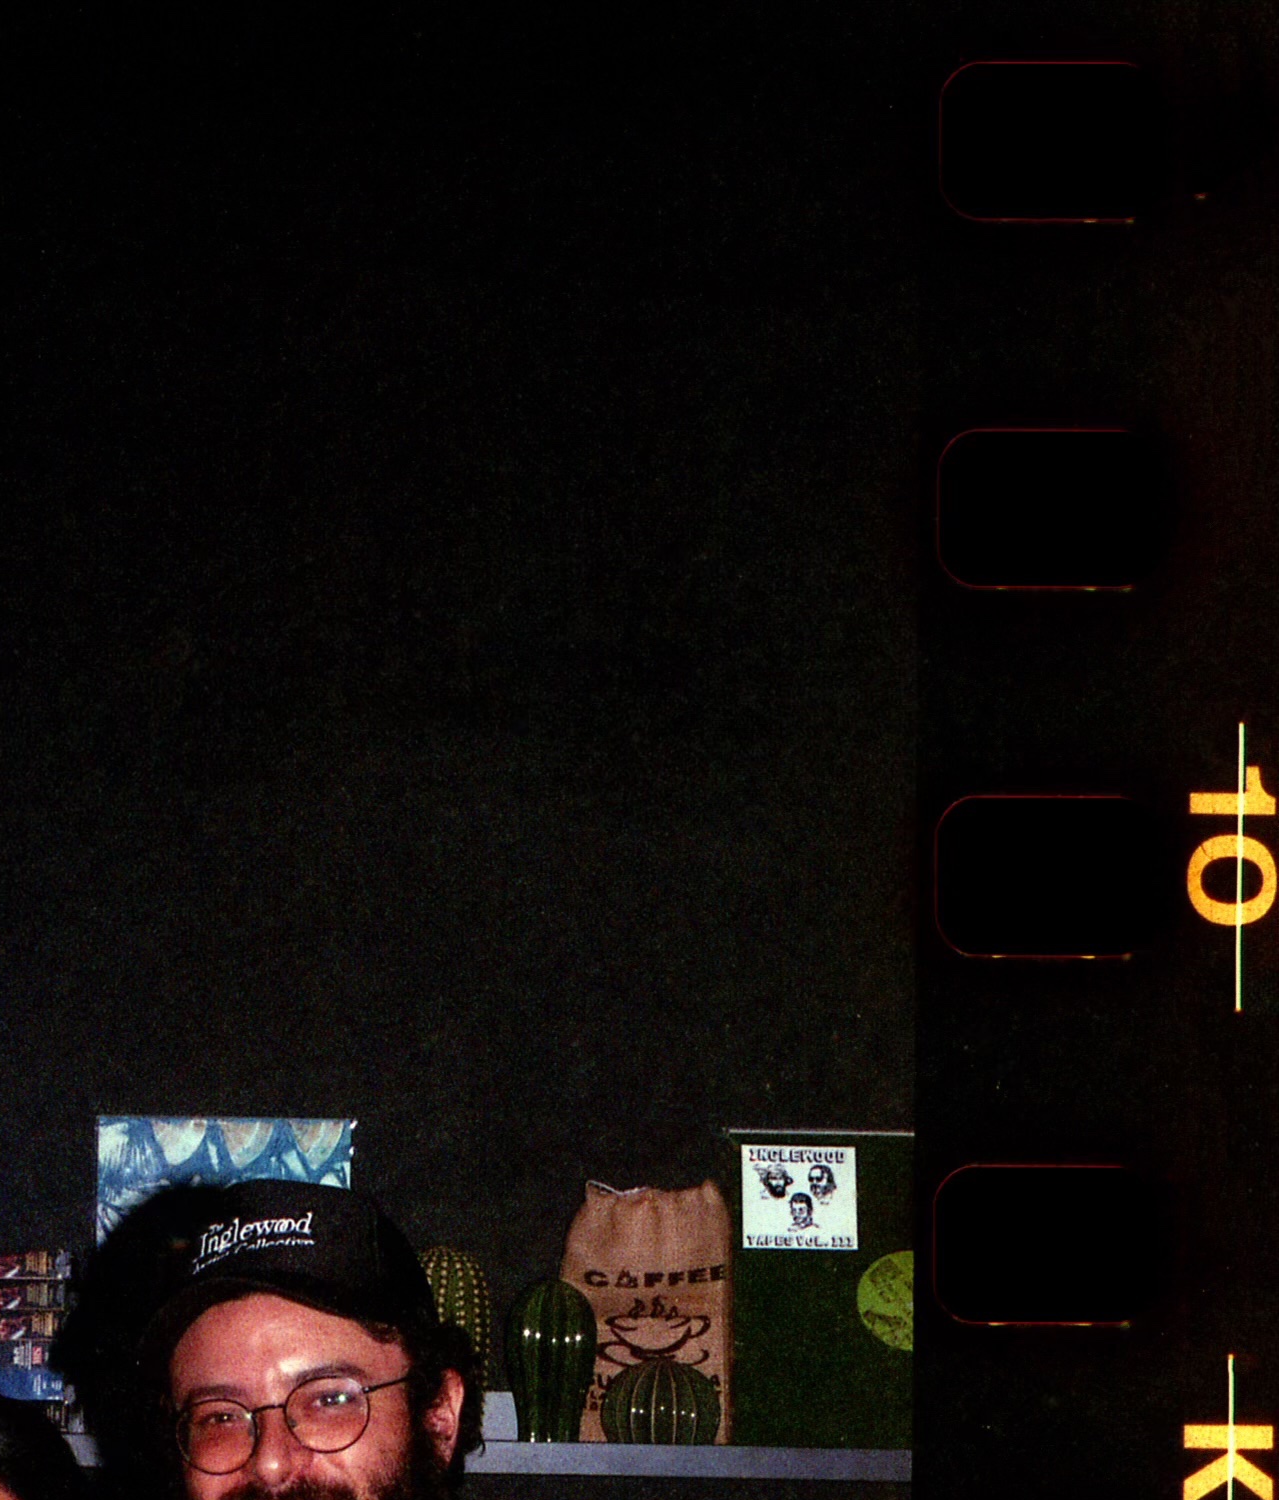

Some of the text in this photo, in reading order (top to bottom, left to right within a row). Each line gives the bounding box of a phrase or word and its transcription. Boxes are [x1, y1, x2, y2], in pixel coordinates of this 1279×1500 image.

[1187, 766, 1278, 926] 10
[748, 1148, 846, 1163] INGLEWOOD
[200, 1211, 313, 1258] Inglewood
